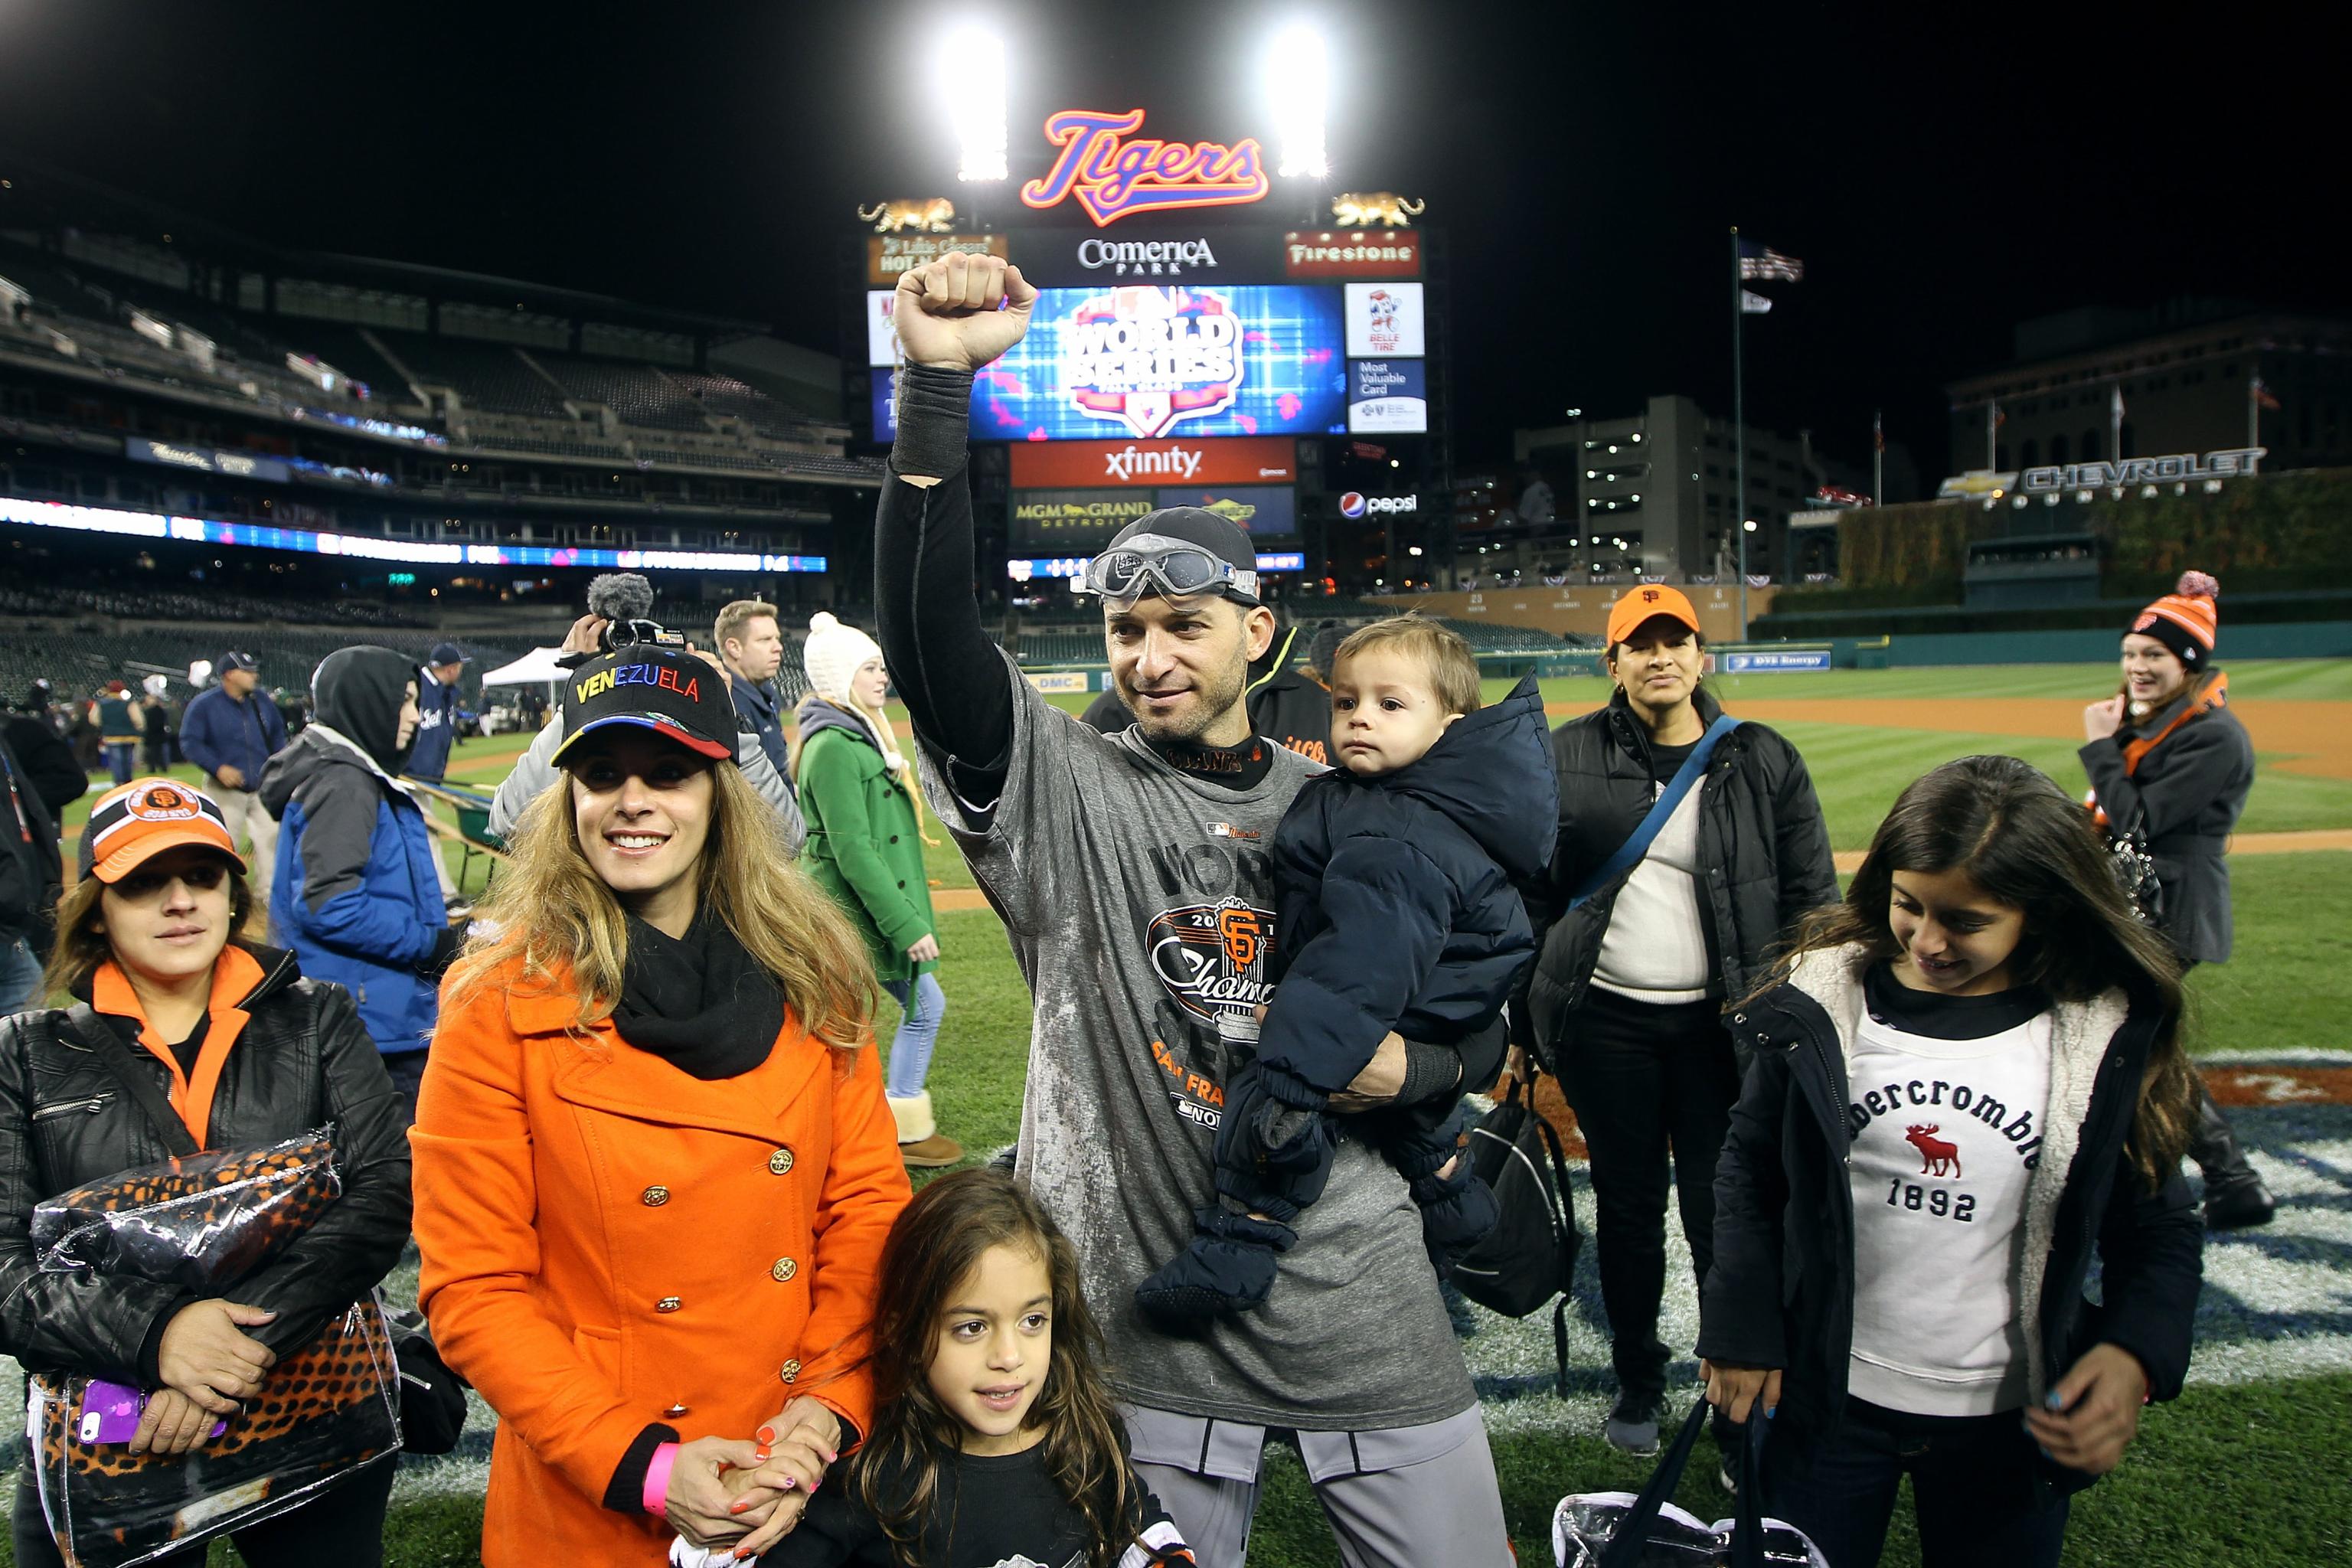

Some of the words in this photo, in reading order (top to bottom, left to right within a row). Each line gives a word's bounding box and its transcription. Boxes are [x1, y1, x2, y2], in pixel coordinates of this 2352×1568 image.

[1021, 109, 1269, 222] Tigers
[1289, 244, 1412, 265] Firestone
[1116, 263, 1181, 276] PARK
[1064, 315, 1236, 352] WORLD
[1370, 333, 1400, 342] BELLE
[1374, 342, 1395, 351] TIRE
[1069, 346, 1235, 387] SERIES
[1359, 362, 1388, 372] Most
[1360, 373, 1406, 384] Valuable
[1361, 384, 1388, 395] Card
[1106, 445, 1202, 481] xfinity
[2024, 448, 2267, 494] CHEVROLET
[1015, 504, 1062, 518] MGM
[1088, 501, 1152, 517] GRAND
[1366, 494, 1417, 515] pepsi
[1041, 518, 1127, 528] DETROIT
[1782, 655, 1821, 665] Energy
[577, 664, 699, 704] VENEZUELA
[1192, 914, 1214, 928] 20
[1220, 909, 1263, 975] SF
[1152, 1041, 1184, 1078] SAN
[1186, 1073, 1225, 1108] FRA
[1886, 1178, 1976, 1222] 1892
